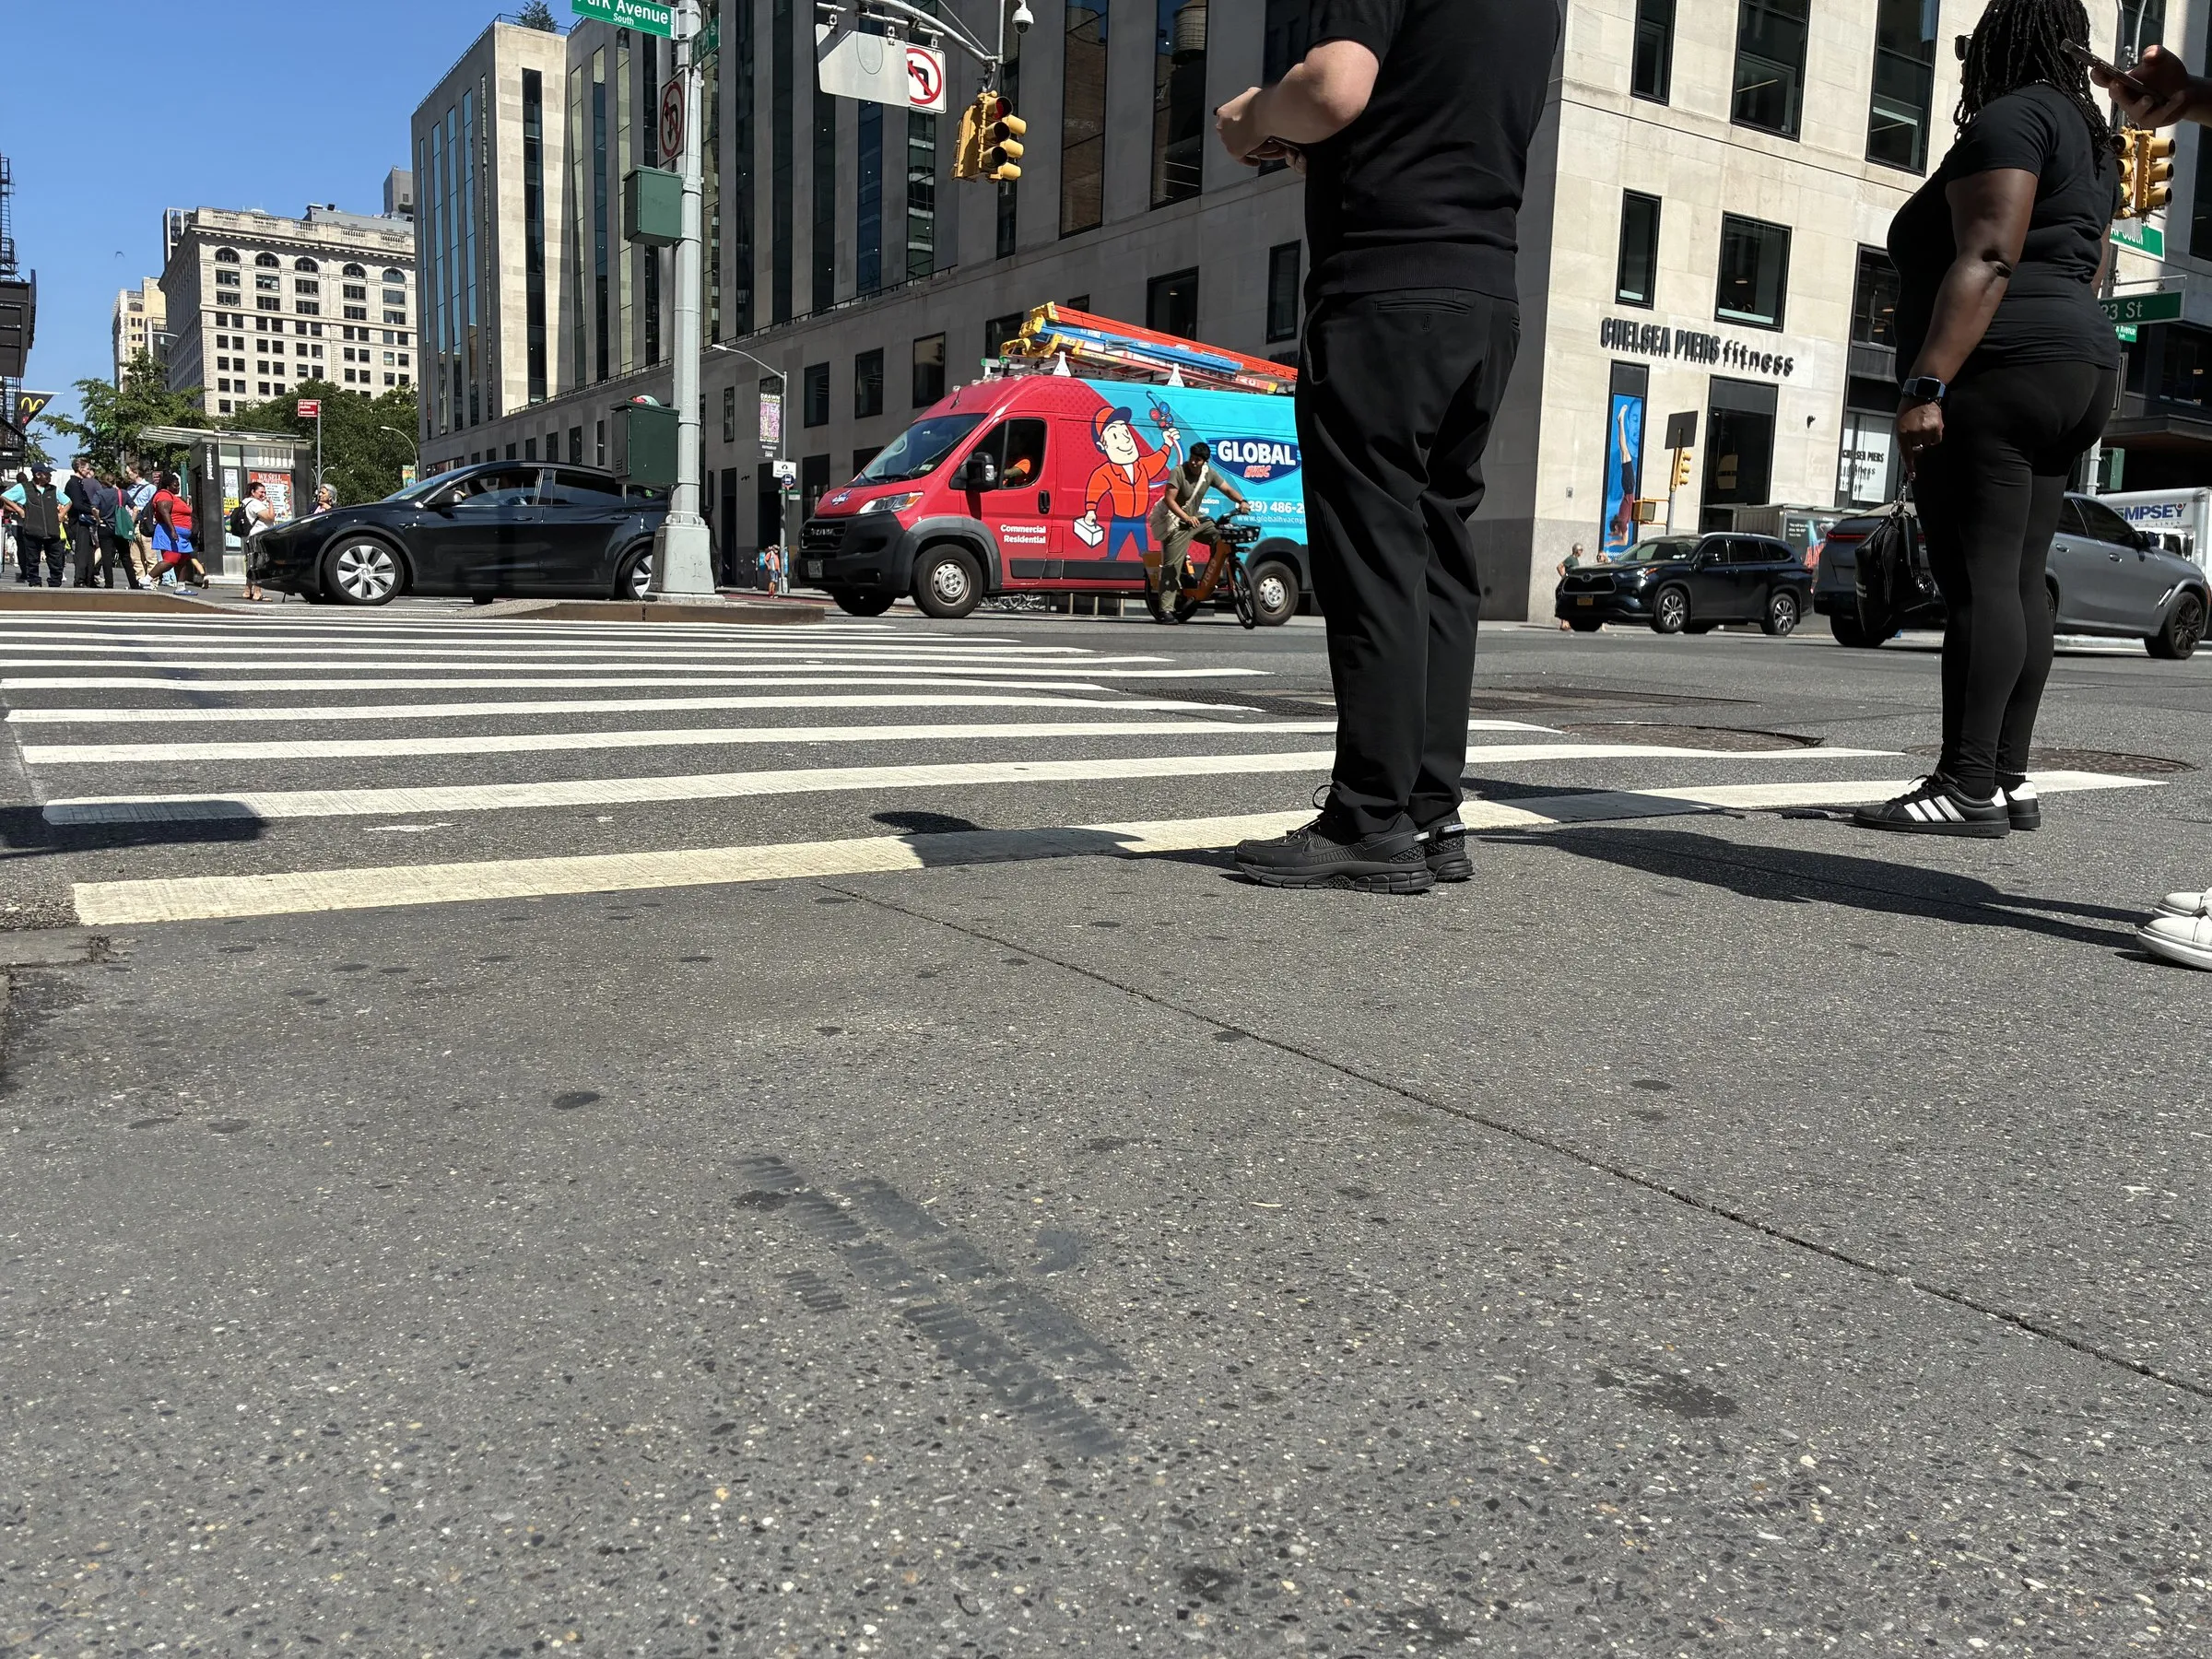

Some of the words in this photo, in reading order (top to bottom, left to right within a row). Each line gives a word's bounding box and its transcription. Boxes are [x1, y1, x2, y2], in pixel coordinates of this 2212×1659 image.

[613, 13, 634, 26] South
[616, 0, 669, 25] Avenue
[2125, 301, 2143, 319] St
[1600, 317, 1671, 359] CHELSEA
[1674, 329, 1721, 365] PIERS
[1723, 339, 1794, 377] fitness
[206, 443, 214, 480] Newsstand
[1218, 441, 1296, 465] GLOBAL
[1867, 451, 1884, 463] PIERS
[1270, 500, 1305, 515] 486-2
[1000, 524, 1046, 534] Commercial
[1003, 535, 1046, 544] Residential
[1203, 558, 1218, 586] JOCO
